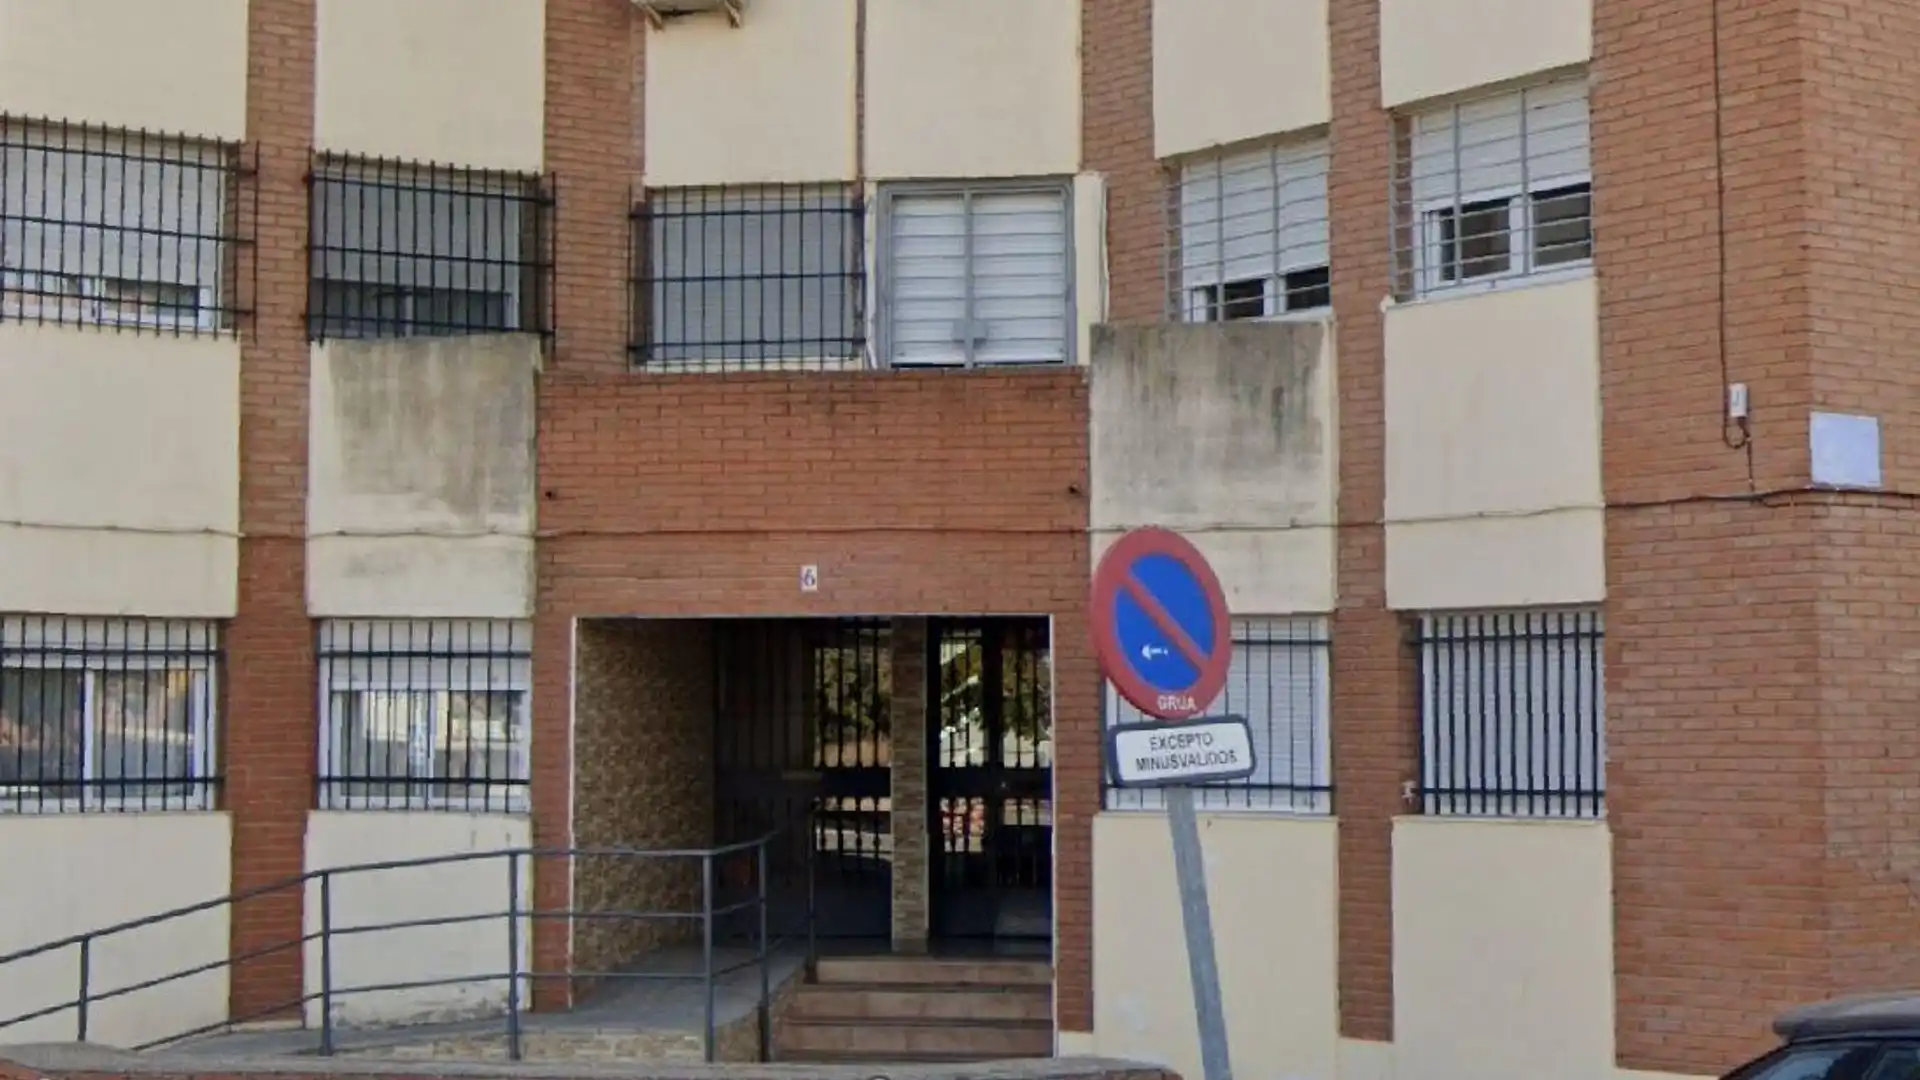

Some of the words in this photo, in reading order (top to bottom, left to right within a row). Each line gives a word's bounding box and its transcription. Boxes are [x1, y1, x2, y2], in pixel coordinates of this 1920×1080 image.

[804, 568, 816, 586] 6
[1157, 694, 1197, 711] GRUA
[1149, 731, 1213, 750] EXCEPTO
